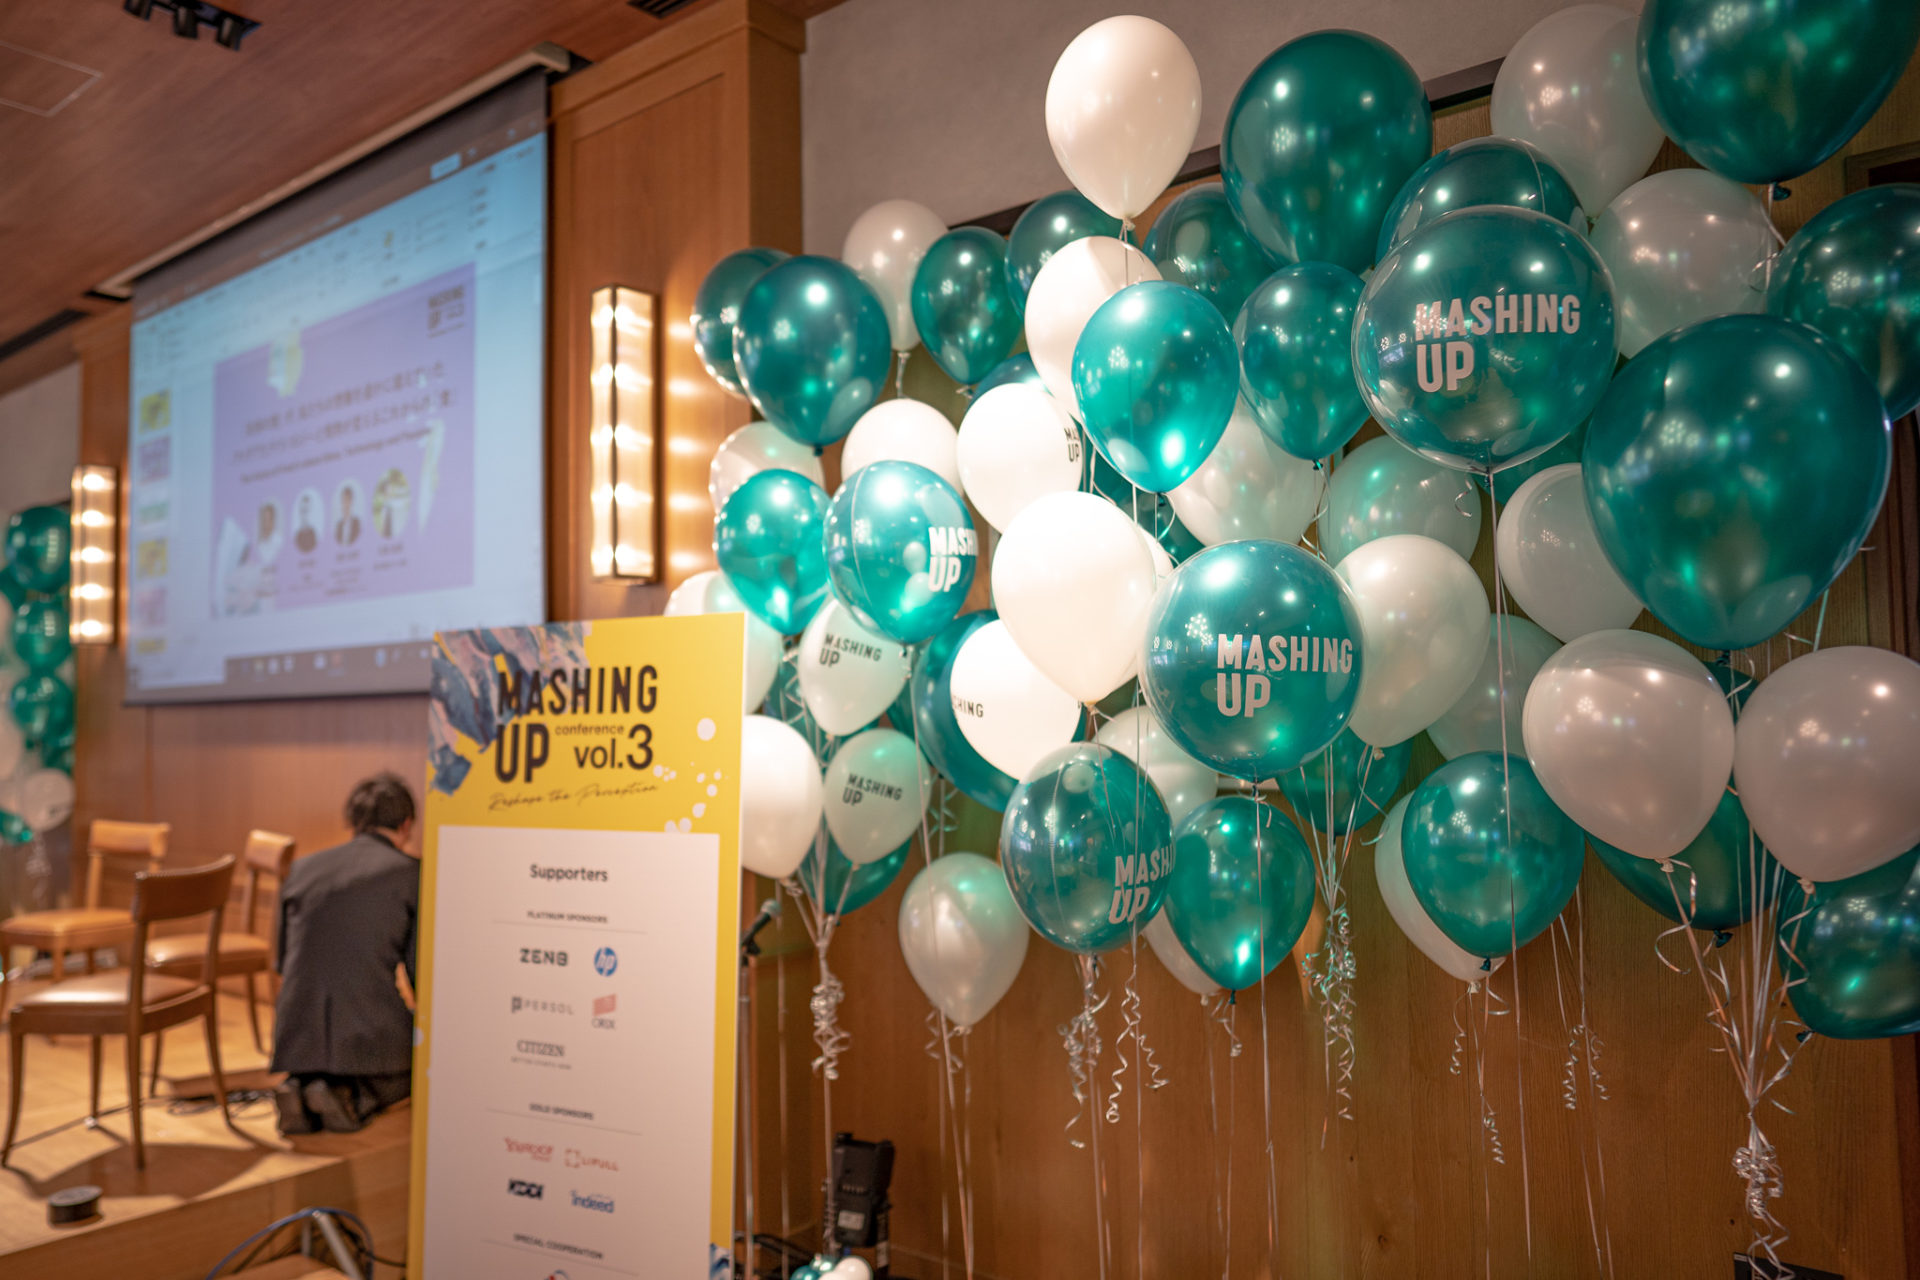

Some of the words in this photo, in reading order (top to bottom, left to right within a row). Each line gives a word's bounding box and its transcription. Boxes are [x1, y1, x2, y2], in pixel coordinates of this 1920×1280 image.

[1415, 294, 1580, 341] MASHING
[1416, 341, 1474, 392] UP
[1068, 443, 1080, 462] UP
[928, 556, 962, 592] UP
[819, 648, 840, 667] UP
[825, 633, 882, 661] MASHING
[1217, 634, 1352, 674] MASHING
[499, 665, 657, 716] MASHING
[1217, 672, 1271, 717] UP
[555, 723, 624, 736] conference
[495, 723, 550, 783] UP
[575, 782, 657, 806] Perception
[842, 788, 863, 806] UP
[848, 773, 903, 800] MASHING
[530, 864, 608, 882] Supporters
[1108, 886, 1150, 924] UP
